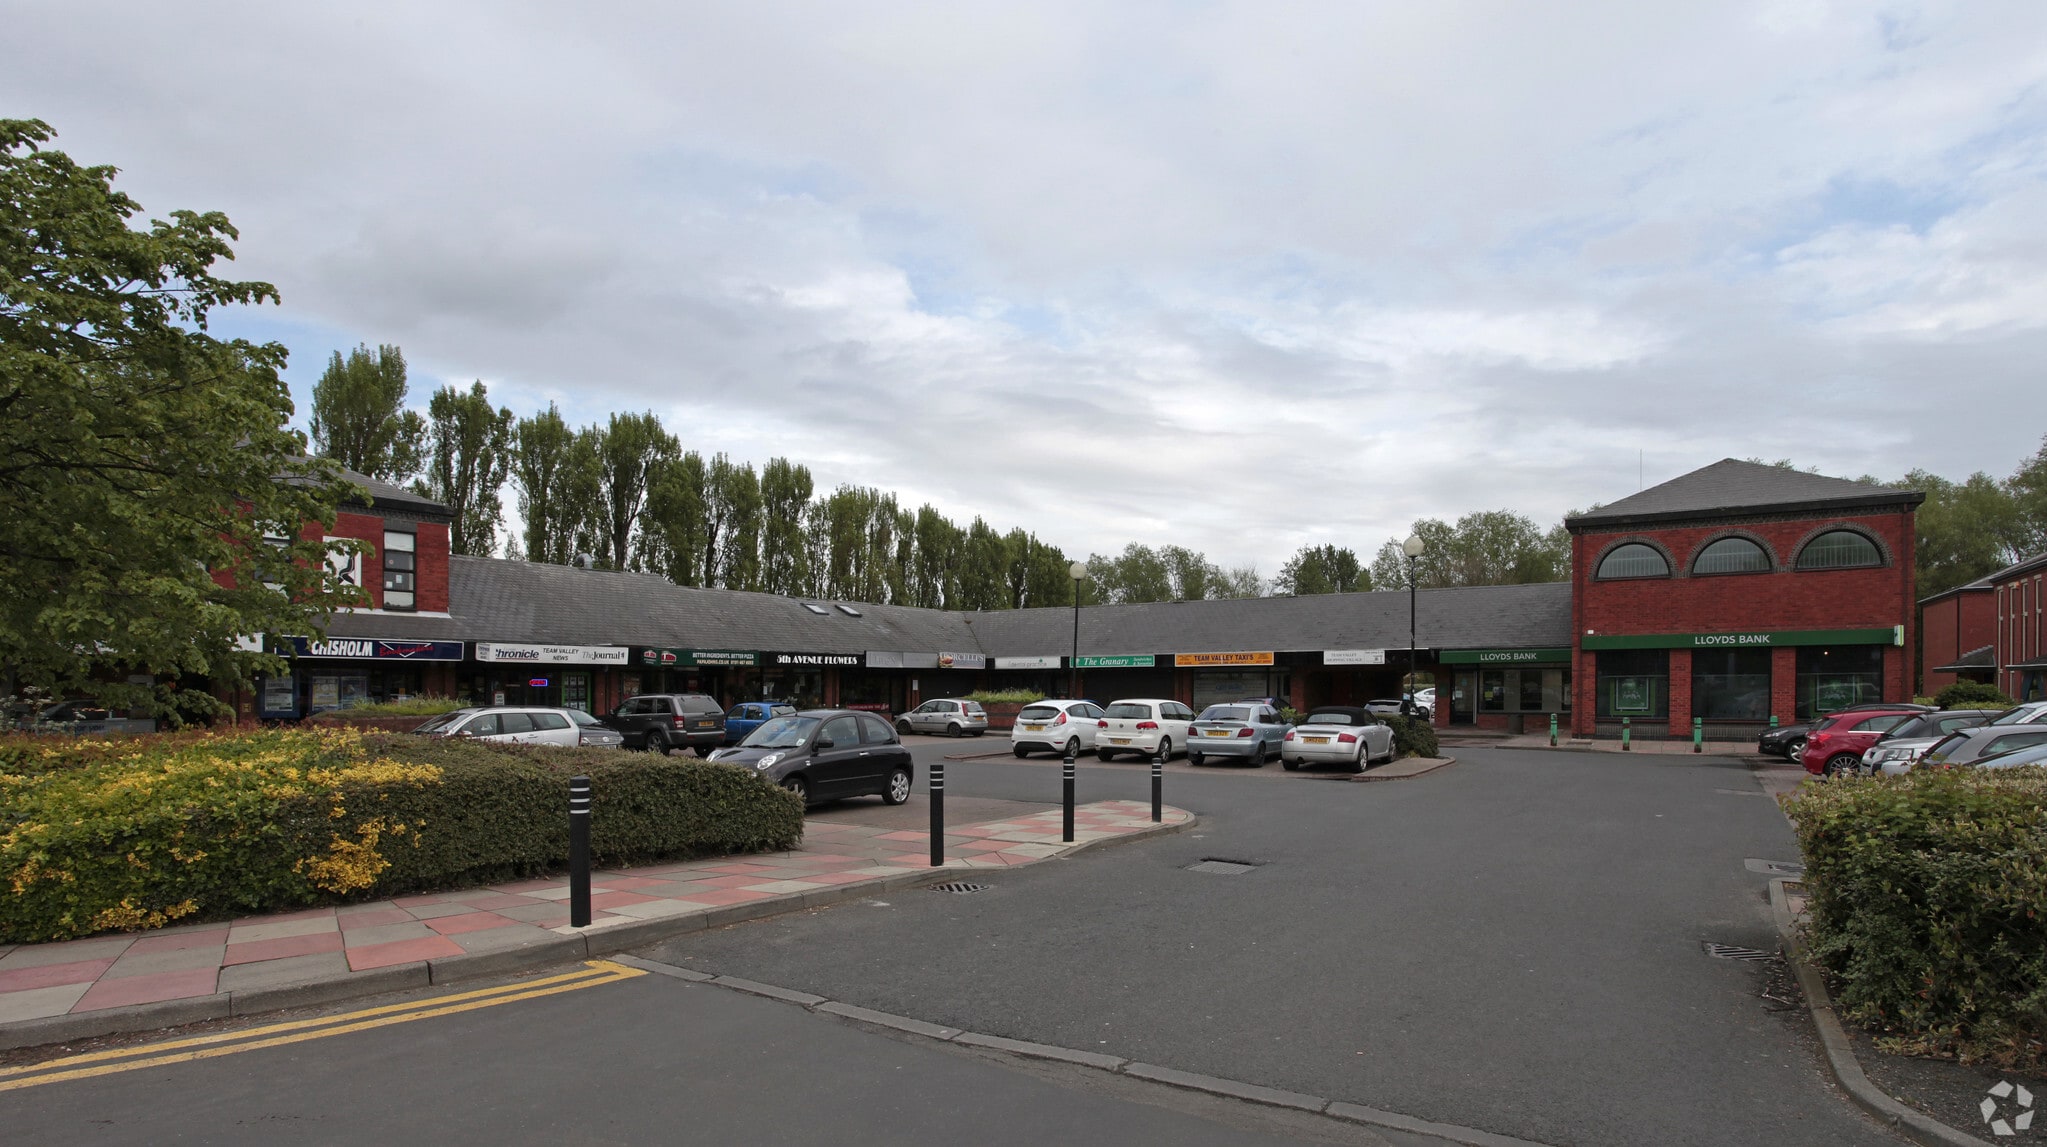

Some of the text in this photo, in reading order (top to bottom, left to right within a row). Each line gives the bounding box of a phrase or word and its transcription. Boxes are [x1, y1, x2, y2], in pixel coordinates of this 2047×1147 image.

[1695, 634, 1770, 645] LLOYDS BANK
[311, 640, 372, 656] CHISHOLM
[495, 648, 539, 659] hronicle
[776, 654, 791, 664] 5th
[792, 655, 823, 664] AVENUE
[824, 656, 858, 665] FLOWERS
[1083, 657, 1097, 666] The
[1099, 657, 1129, 666] Granary
[1480, 652, 1537, 661] LLOYDS BANK
